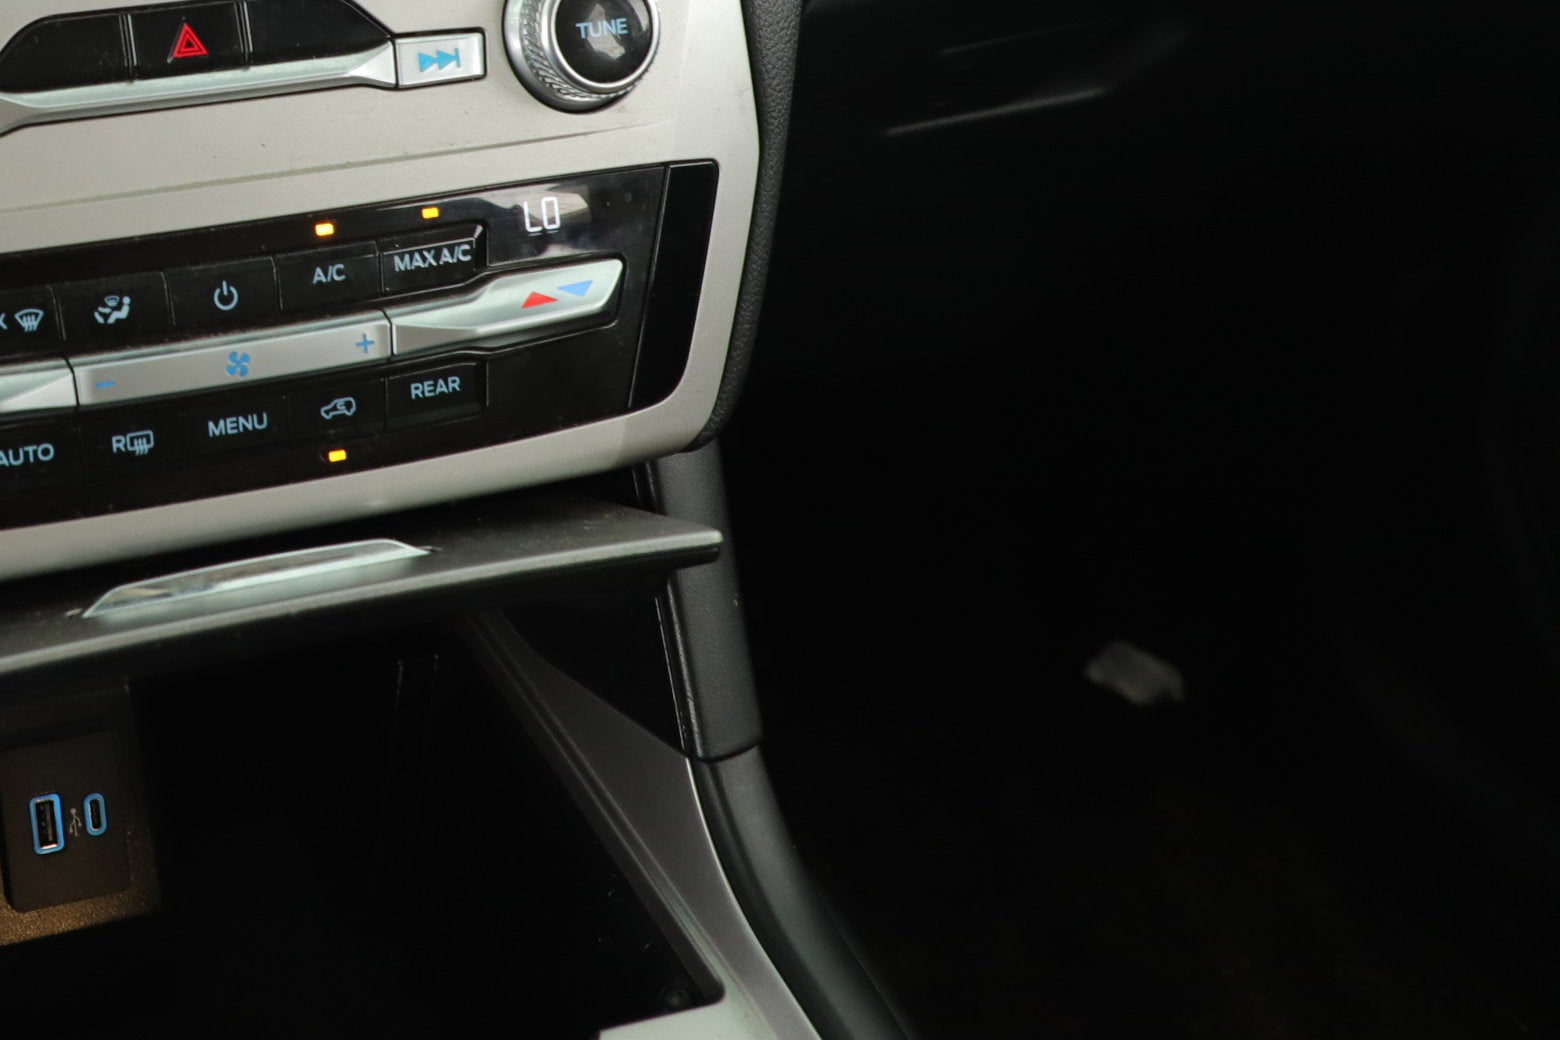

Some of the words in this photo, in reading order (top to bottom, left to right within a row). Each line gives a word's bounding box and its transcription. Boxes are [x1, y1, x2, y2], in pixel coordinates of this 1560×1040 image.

[575, 17, 629, 39] TUNE
[523, 196, 562, 233] LO
[393, 251, 437, 273] MAX
[440, 244, 473, 266] A/C
[312, 263, 347, 285] A/C
[410, 375, 462, 400] REAR
[207, 412, 269, 438] MENU
